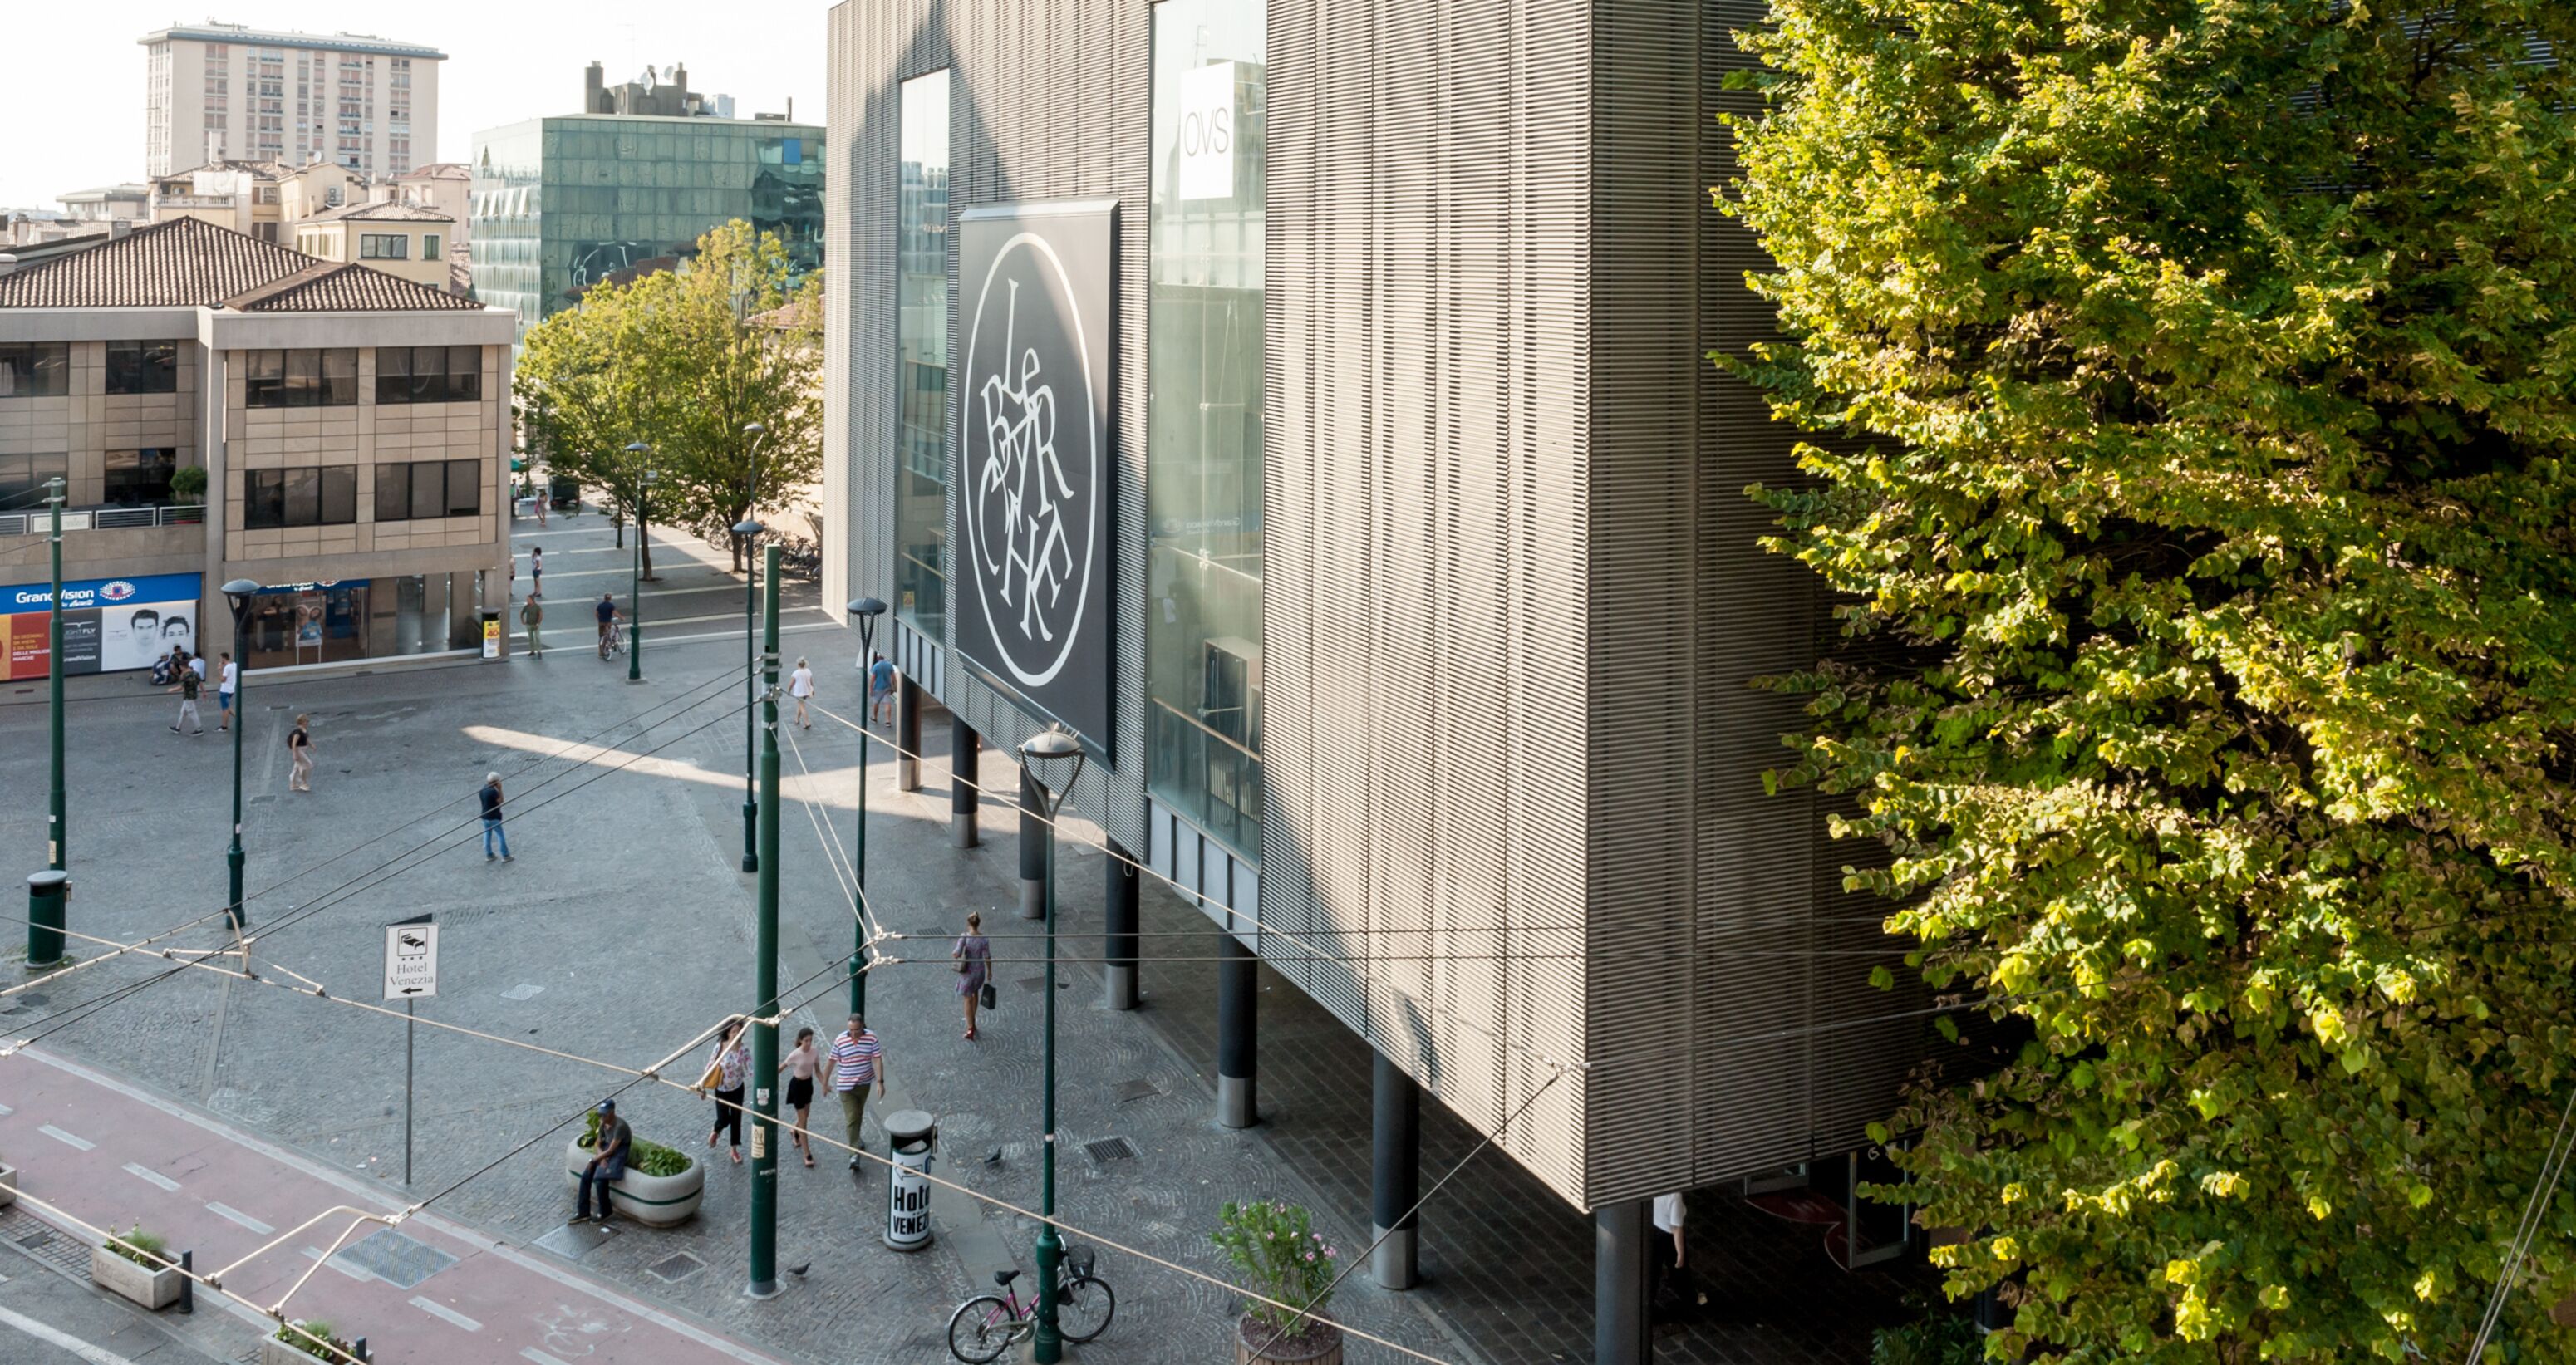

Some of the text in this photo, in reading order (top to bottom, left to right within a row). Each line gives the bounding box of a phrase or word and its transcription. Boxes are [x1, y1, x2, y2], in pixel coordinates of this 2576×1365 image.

[1184, 107, 1229, 157] OVS
[397, 962, 427, 975] Hotel
[390, 974, 434, 986] Venezia
